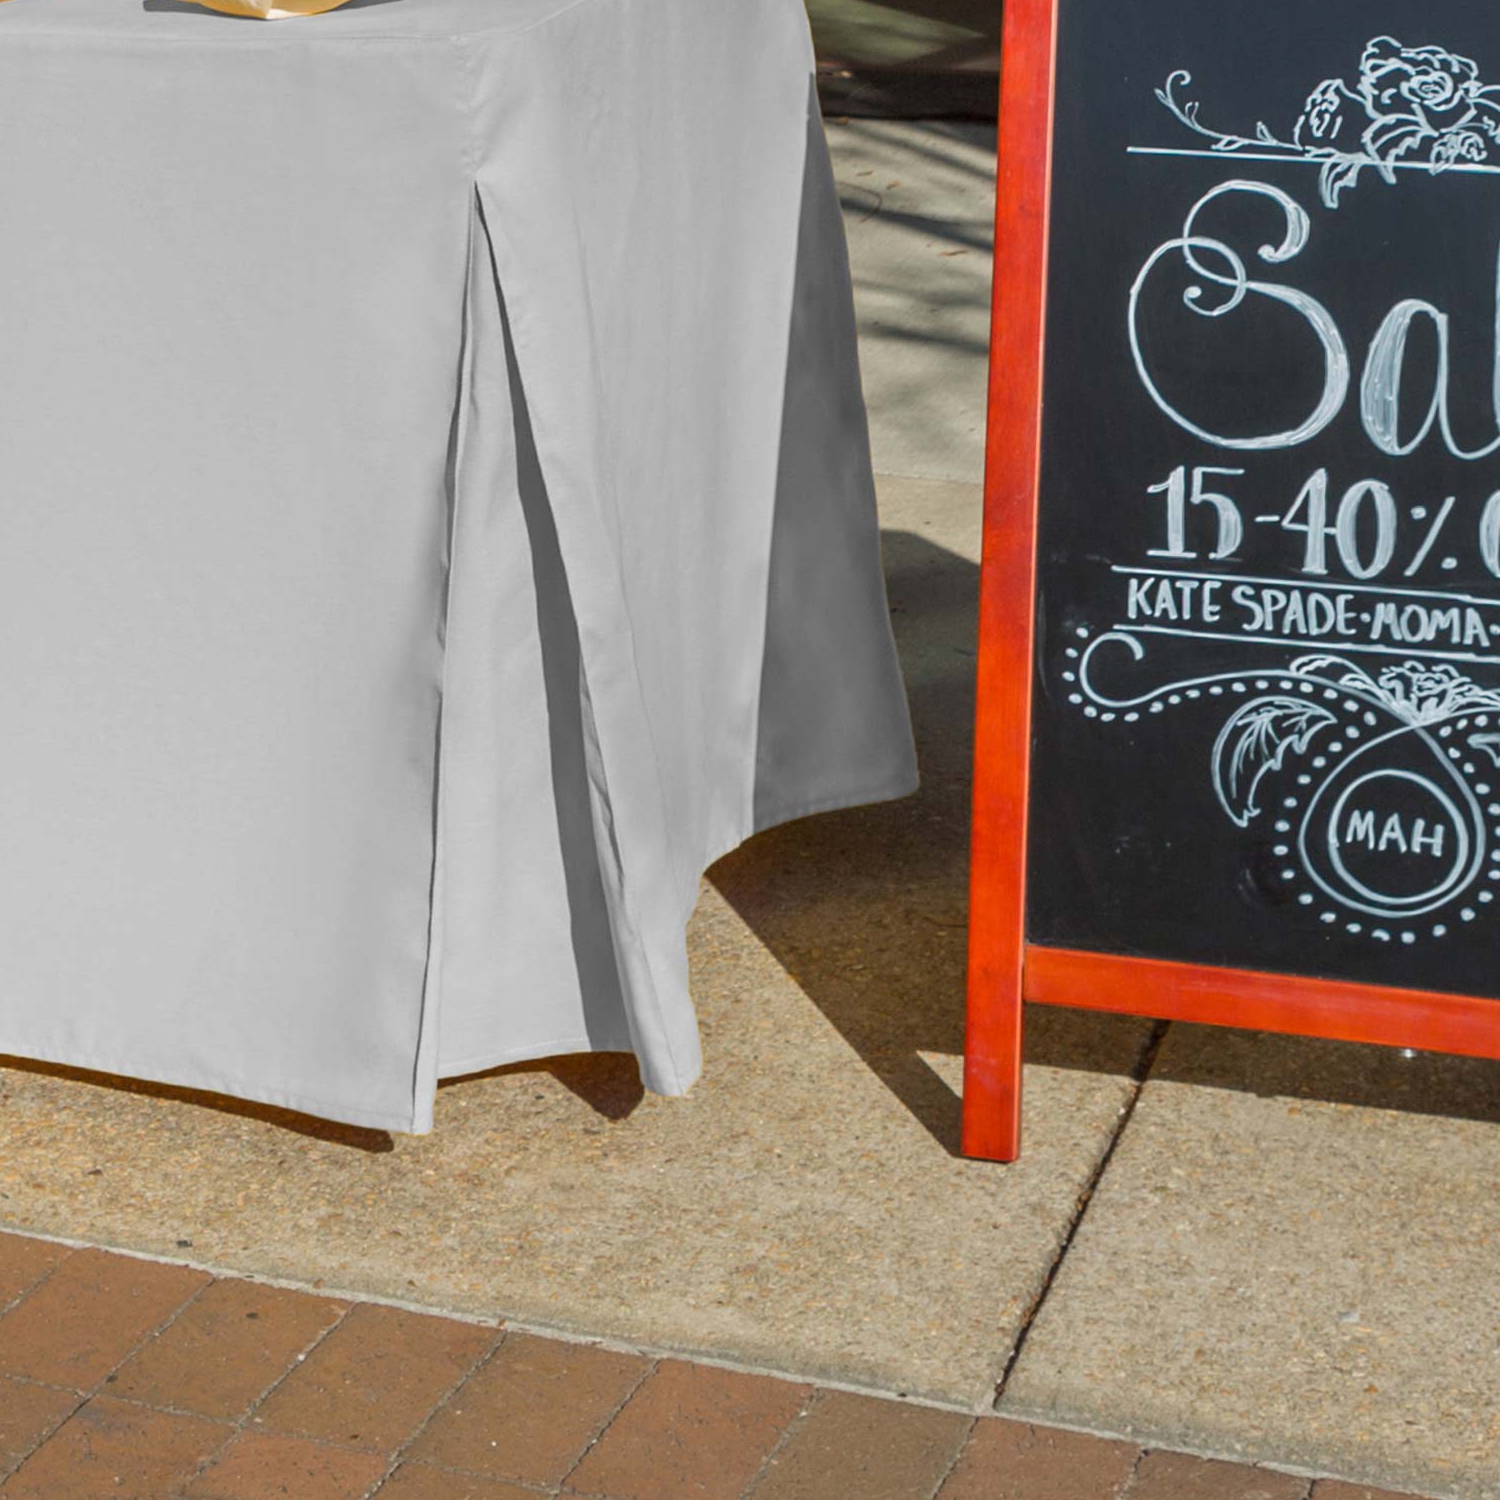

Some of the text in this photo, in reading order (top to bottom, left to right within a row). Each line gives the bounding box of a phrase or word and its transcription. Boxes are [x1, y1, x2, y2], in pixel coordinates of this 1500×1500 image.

[1128, 179, 1500, 460] Sa
[1127, 577, 1222, 622] KATE
[1346, 810, 1444, 857] MAH
